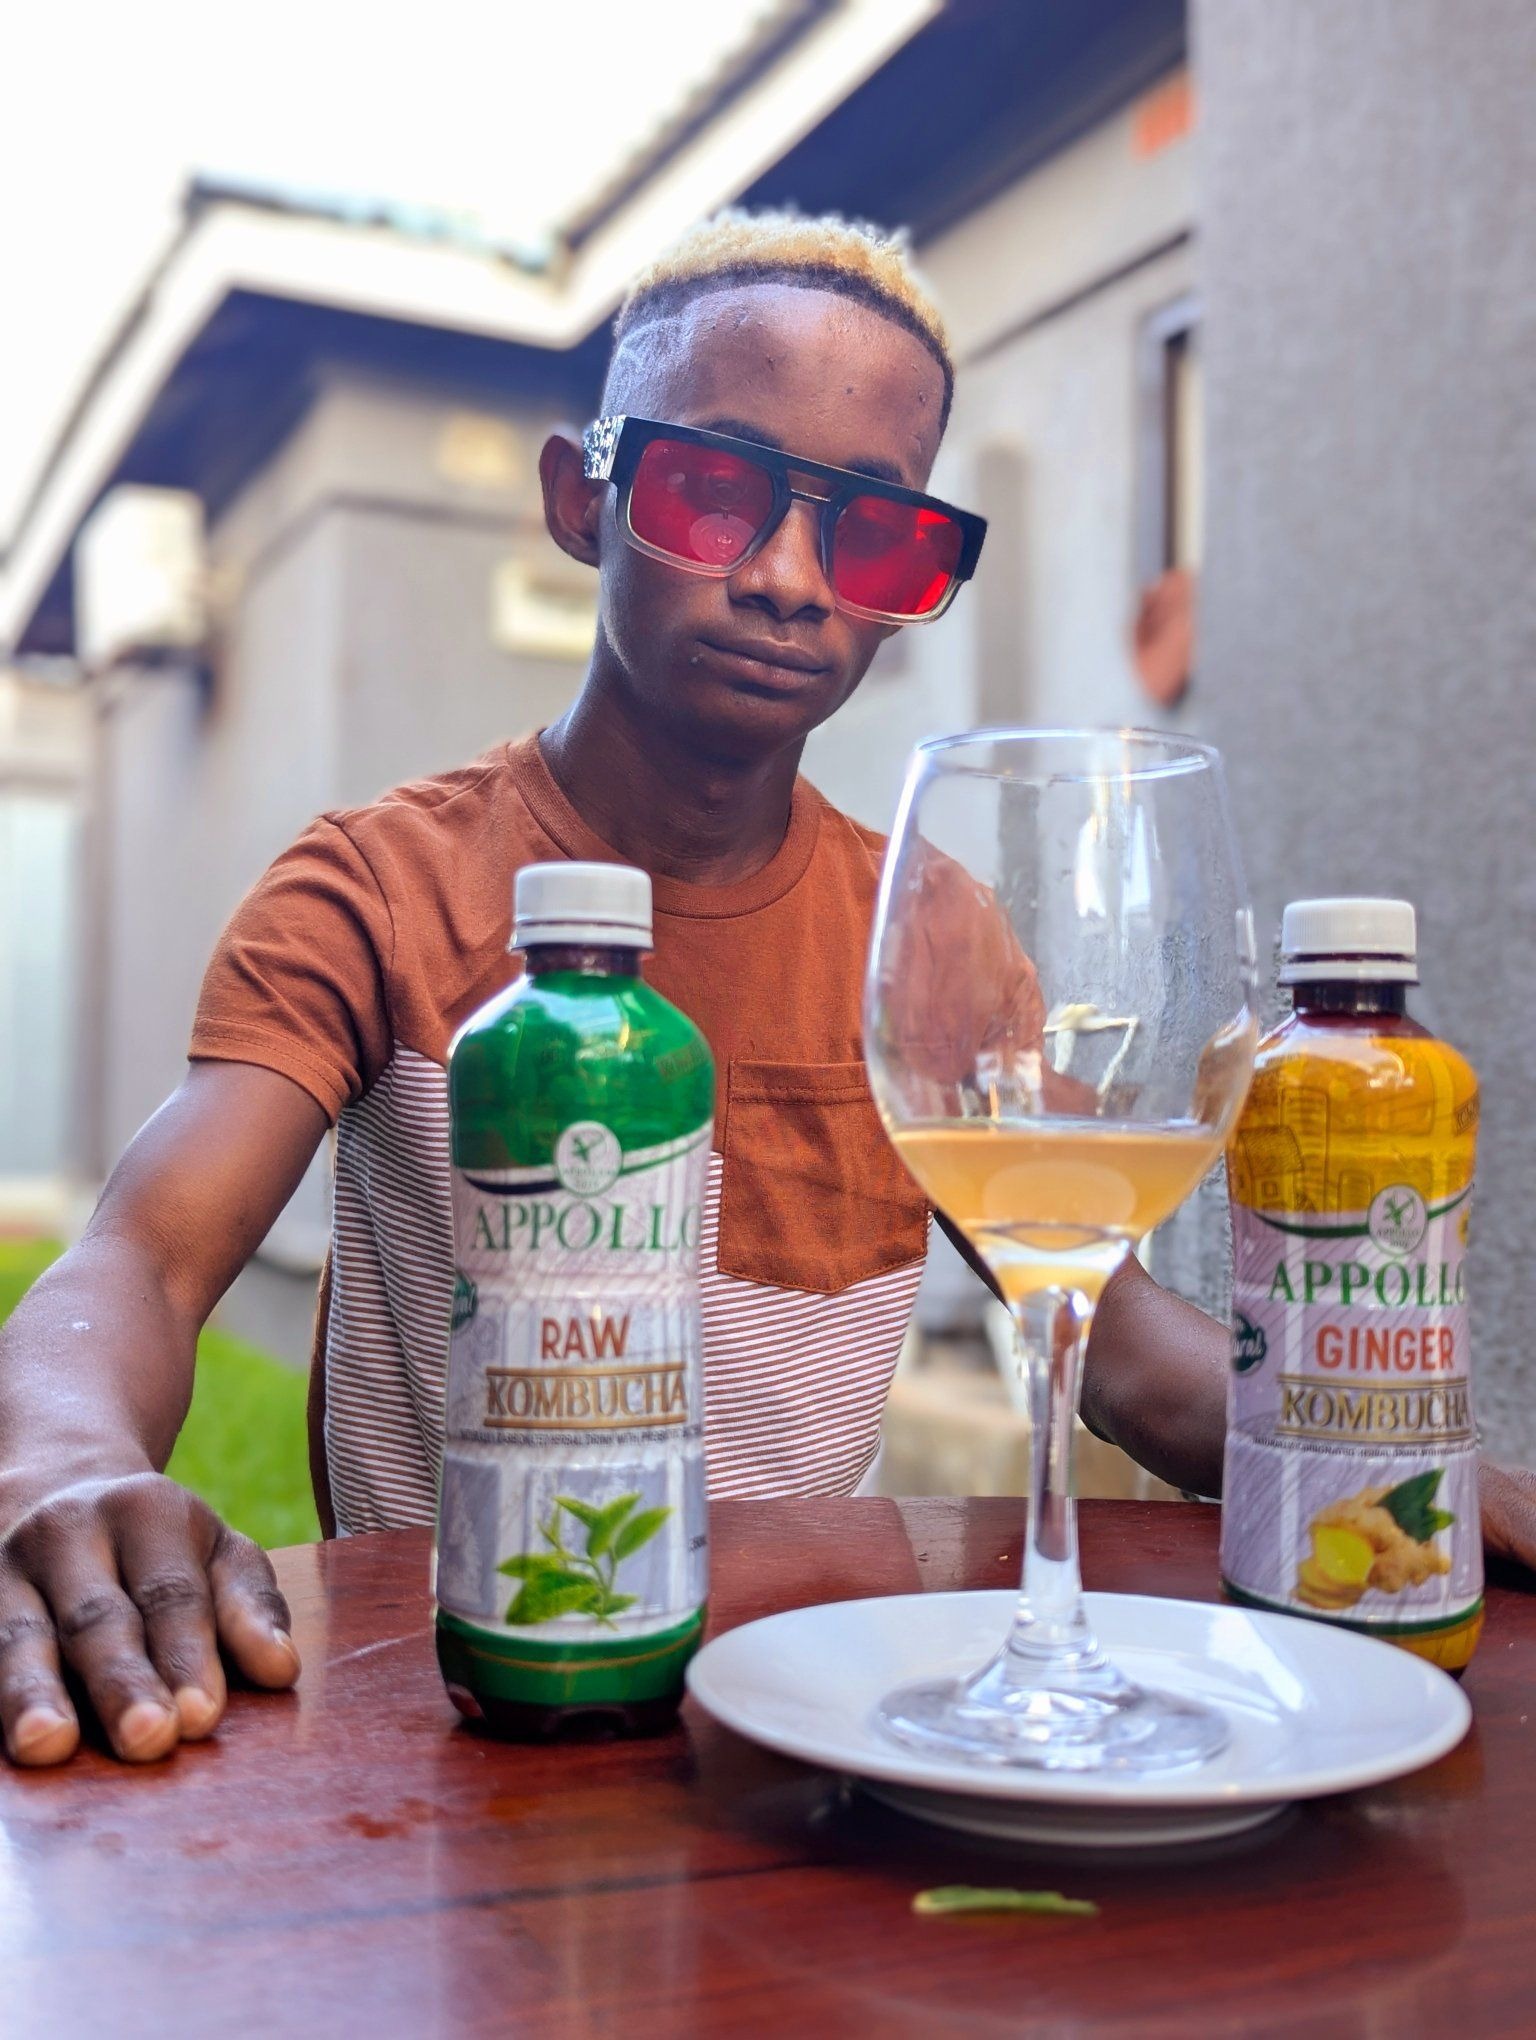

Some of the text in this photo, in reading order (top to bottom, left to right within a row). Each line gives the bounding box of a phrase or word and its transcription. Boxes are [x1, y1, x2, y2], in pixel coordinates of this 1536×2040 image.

[540, 1315, 629, 1360] RAW
[1316, 1325, 1454, 1371] GINGER
[485, 1374, 688, 1418] KOMBUCHA
[1279, 1388, 1469, 1431] KOMBUCHA
